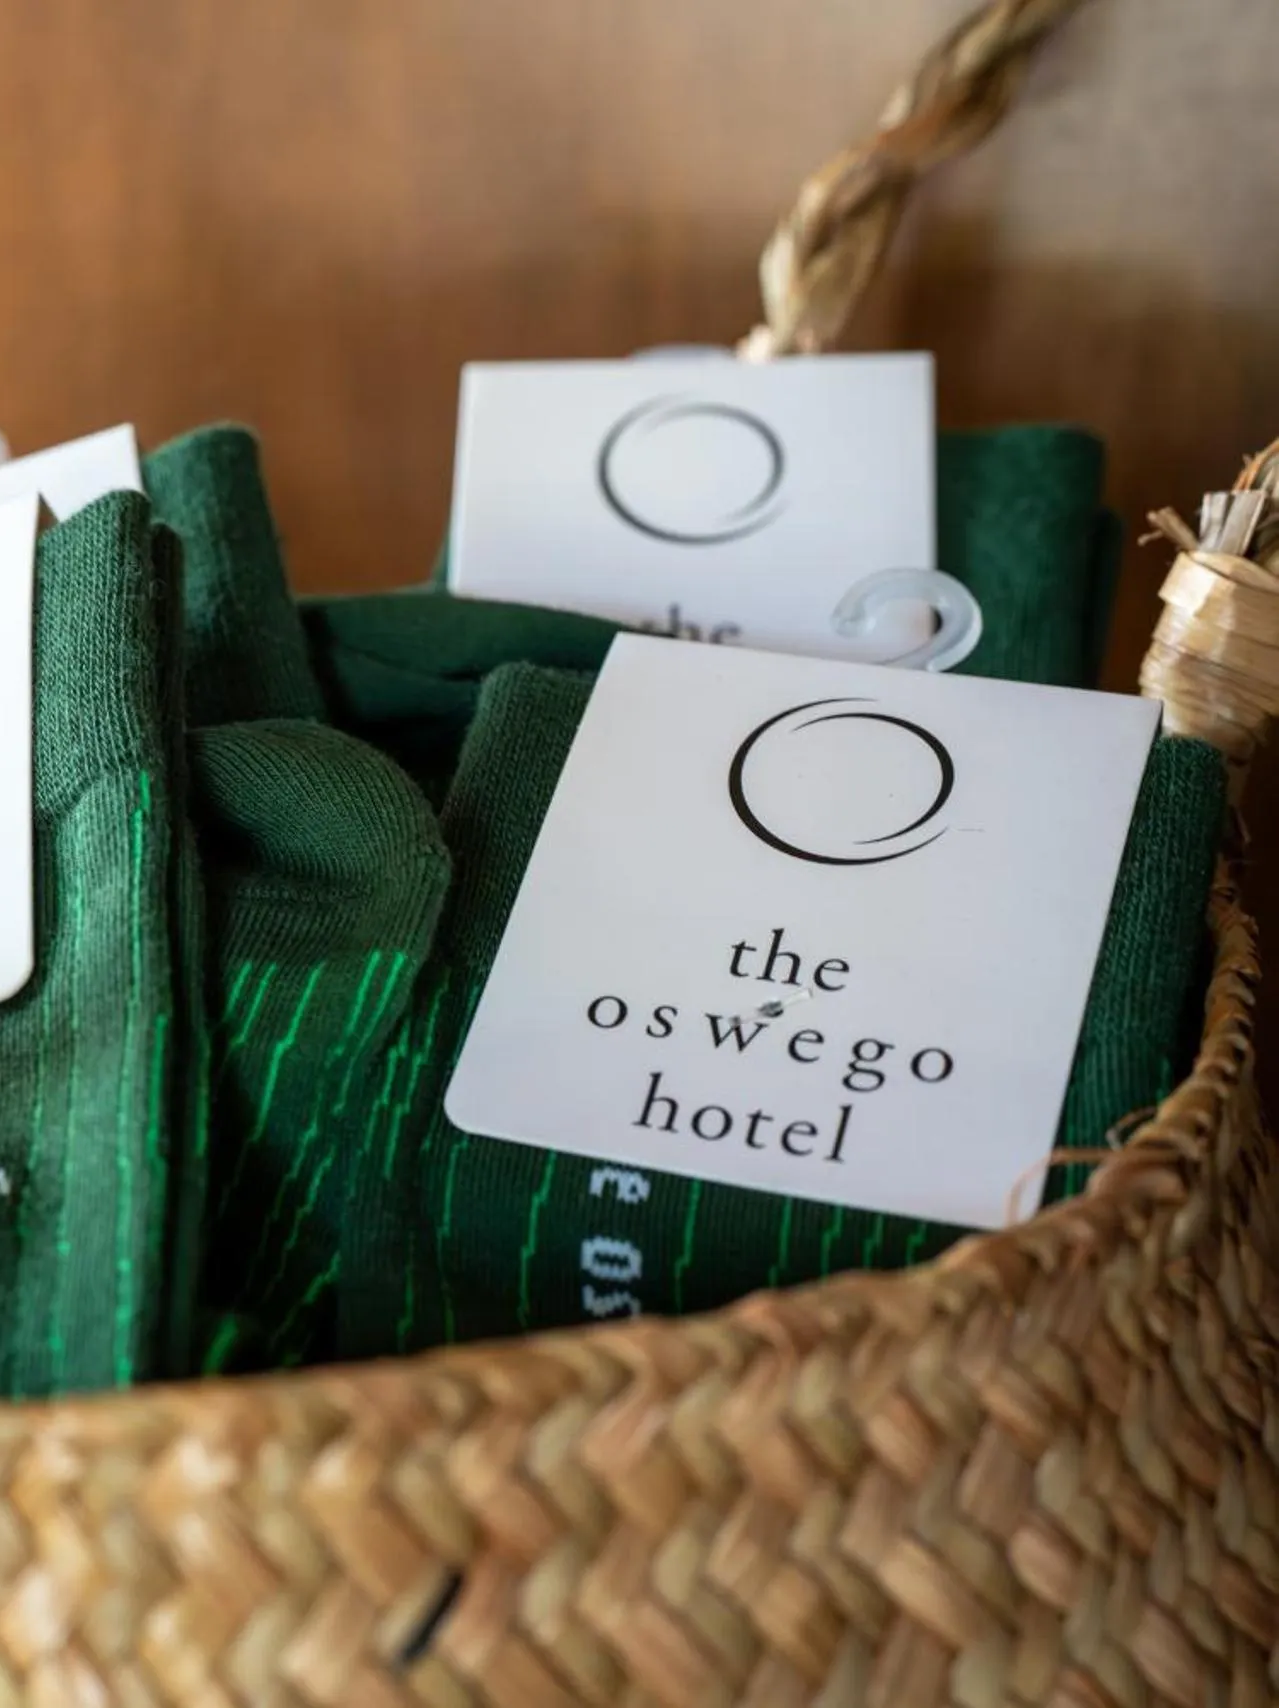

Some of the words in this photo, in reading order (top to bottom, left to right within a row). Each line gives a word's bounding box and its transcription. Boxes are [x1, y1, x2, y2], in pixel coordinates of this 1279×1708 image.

[728, 927, 851, 992] the
[586, 995, 955, 1093] oswego
[631, 1071, 854, 1163] hotel
